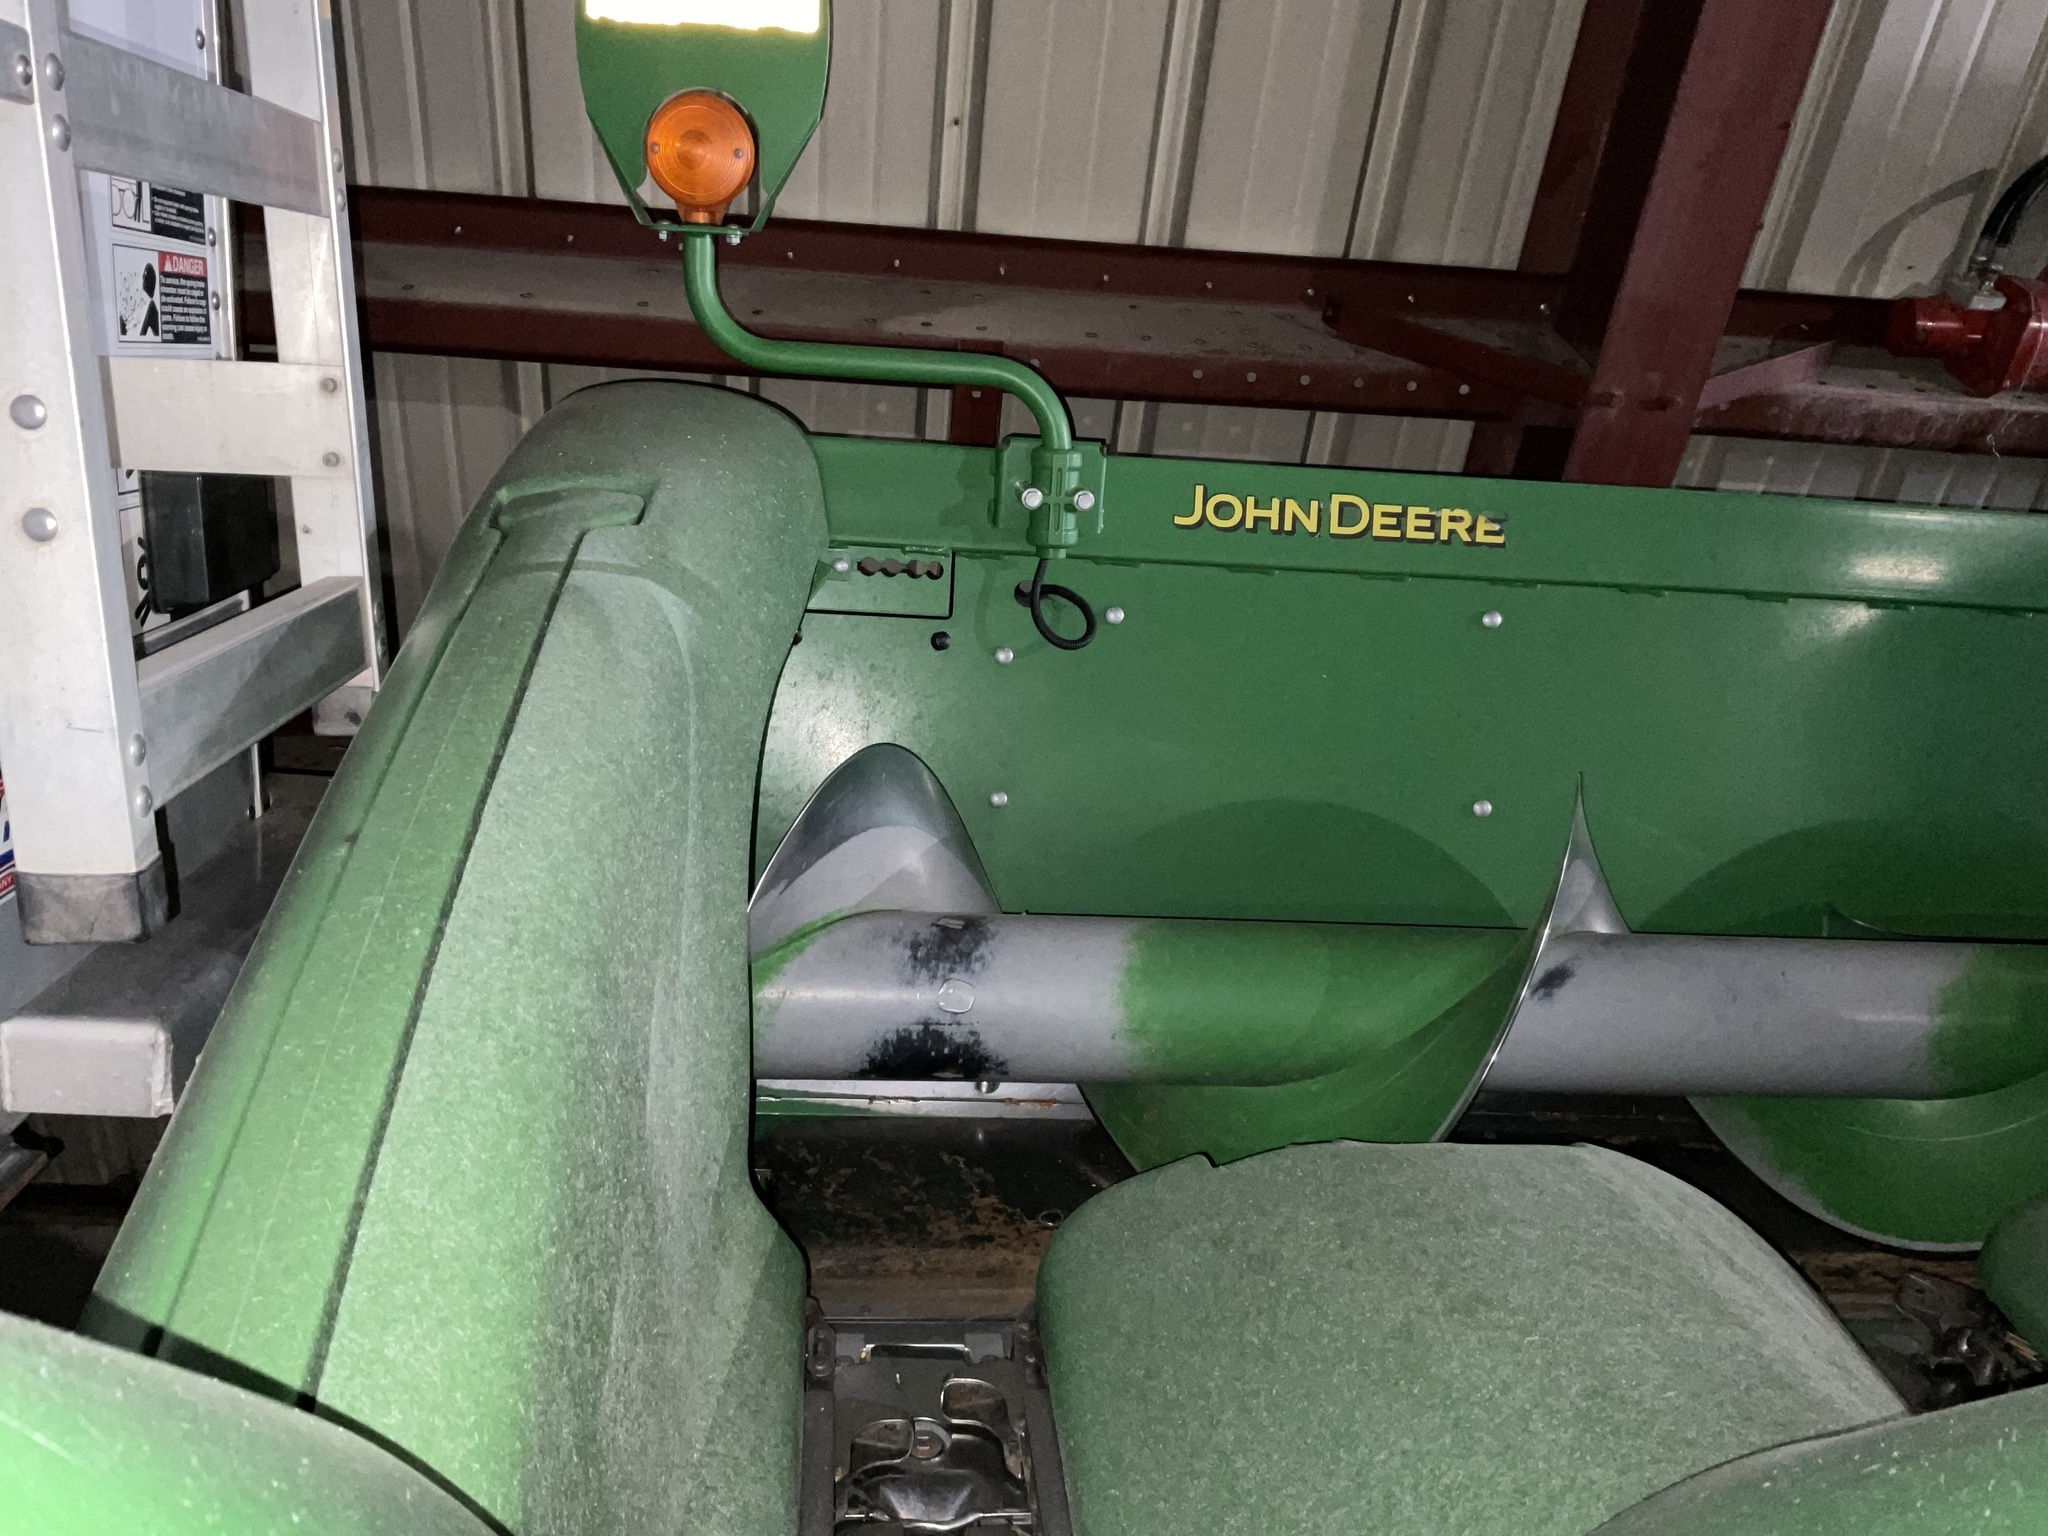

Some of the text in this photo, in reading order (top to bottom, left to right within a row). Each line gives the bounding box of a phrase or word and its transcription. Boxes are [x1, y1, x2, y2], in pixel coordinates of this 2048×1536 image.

[172, 255, 204, 275] DANGER
[1173, 484, 1506, 547] JOHN DEERE
